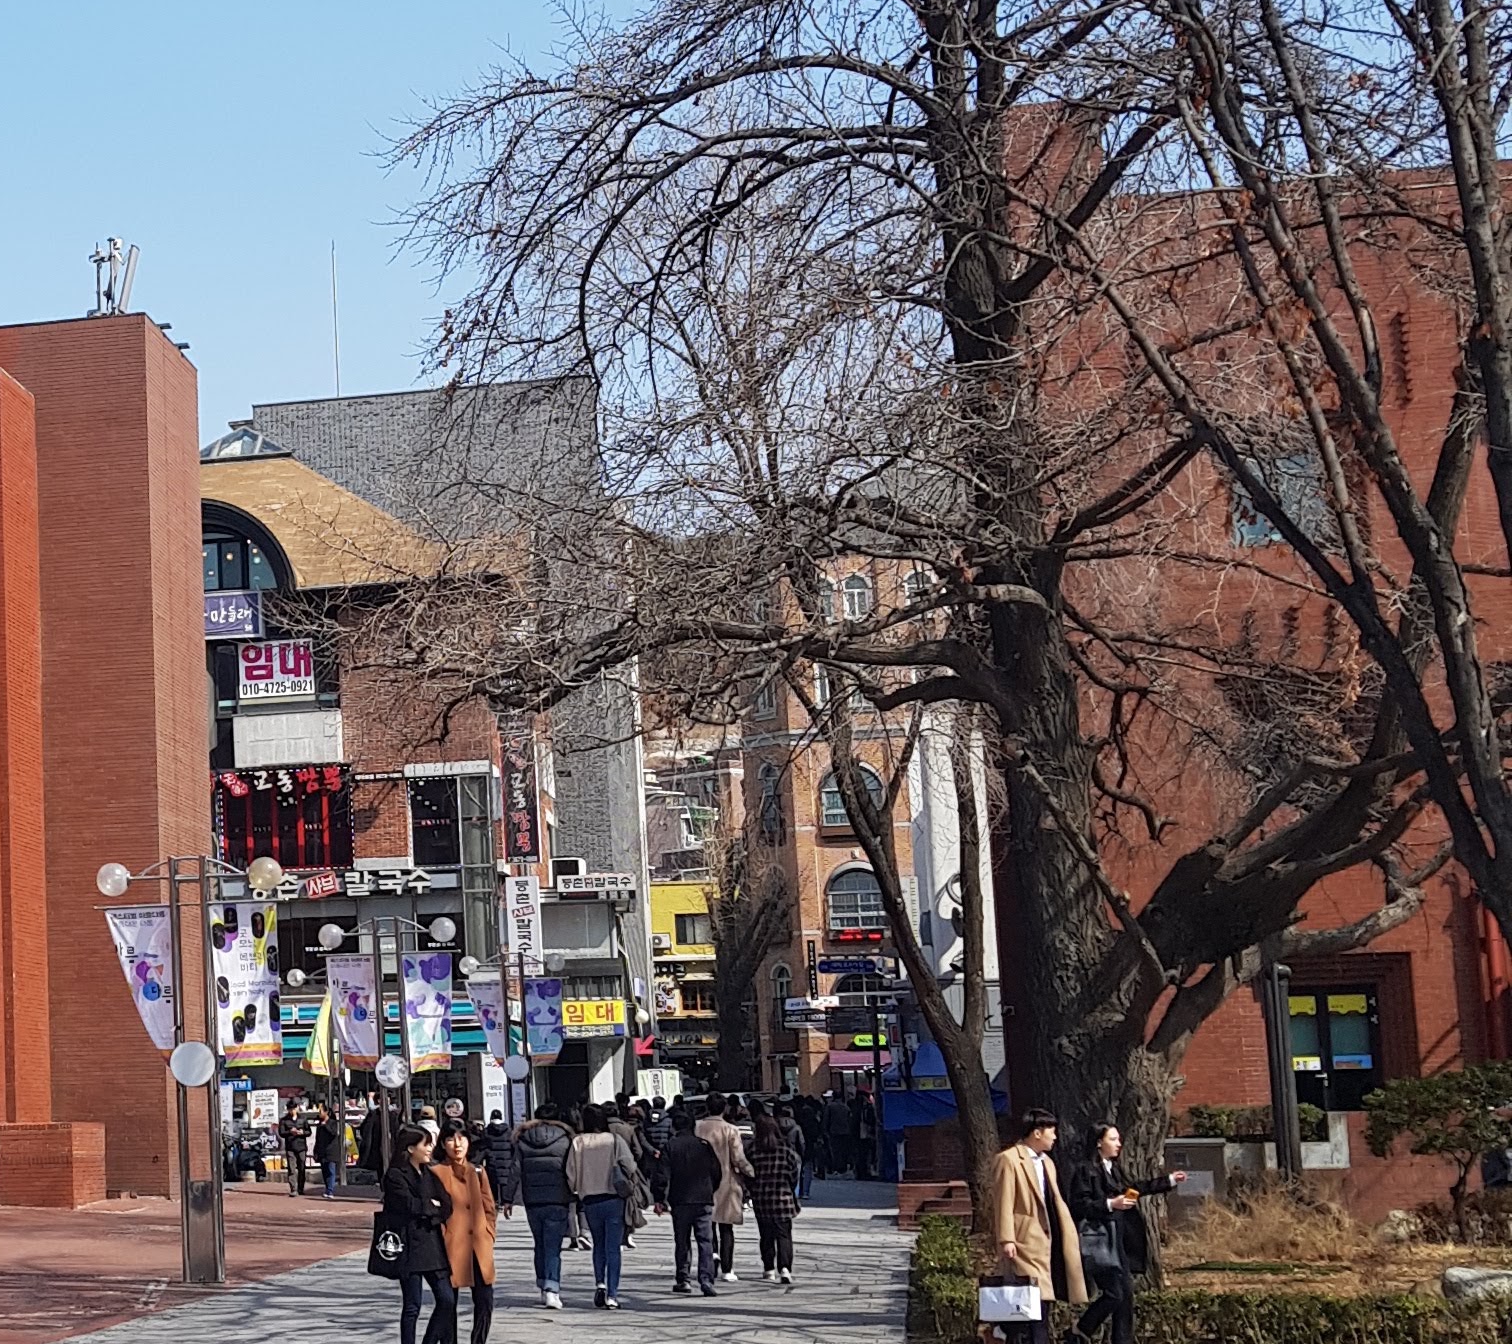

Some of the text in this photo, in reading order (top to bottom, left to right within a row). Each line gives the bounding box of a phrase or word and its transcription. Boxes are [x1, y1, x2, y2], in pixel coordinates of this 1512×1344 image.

[241, 641, 312, 680] 임대
[242, 680, 313, 695] 010-4725-0921
[308, 874, 335, 897] 샤브
[344, 868, 433, 897] 칼국수
[565, 1002, 615, 1022] 임대
